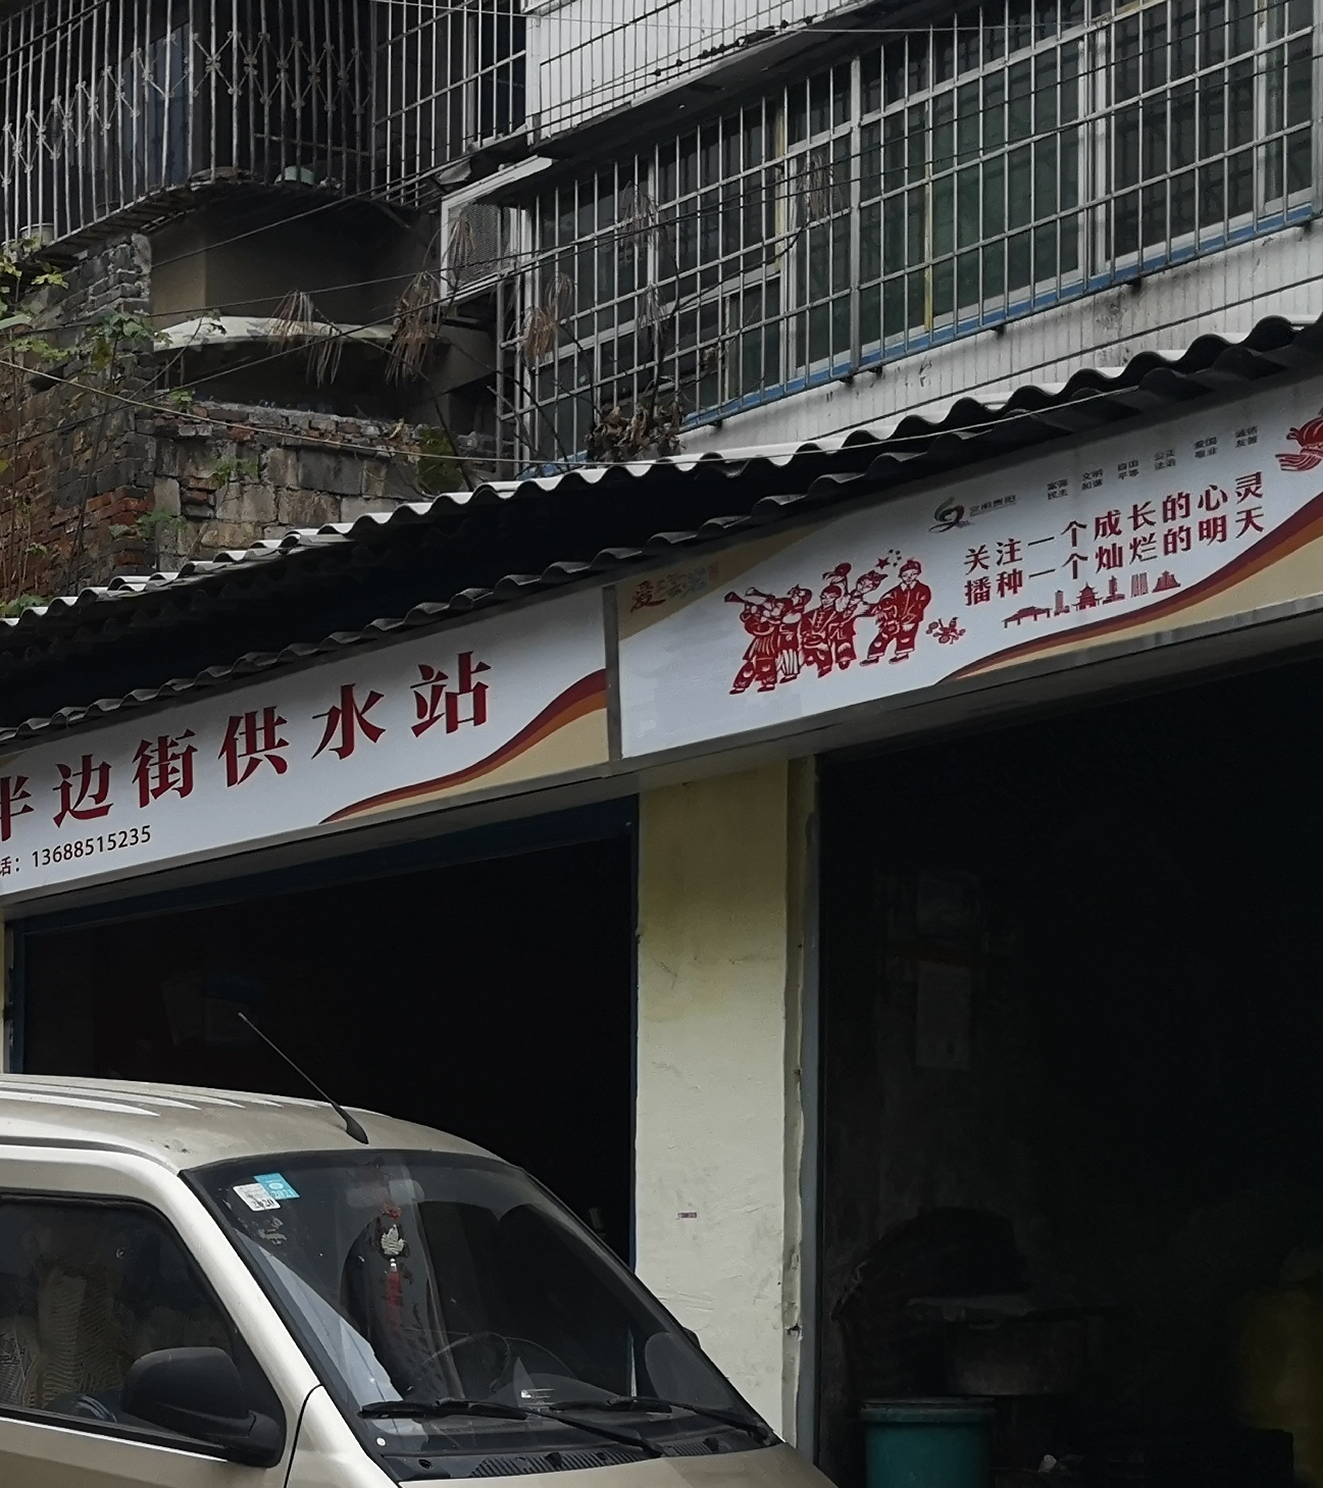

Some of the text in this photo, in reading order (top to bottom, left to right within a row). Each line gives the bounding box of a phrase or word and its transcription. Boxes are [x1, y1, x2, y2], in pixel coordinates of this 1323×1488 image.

[963, 471, 1264, 576] 关注一个成长的心灵
[963, 506, 1265, 606] 播种一个灿烂的明天
